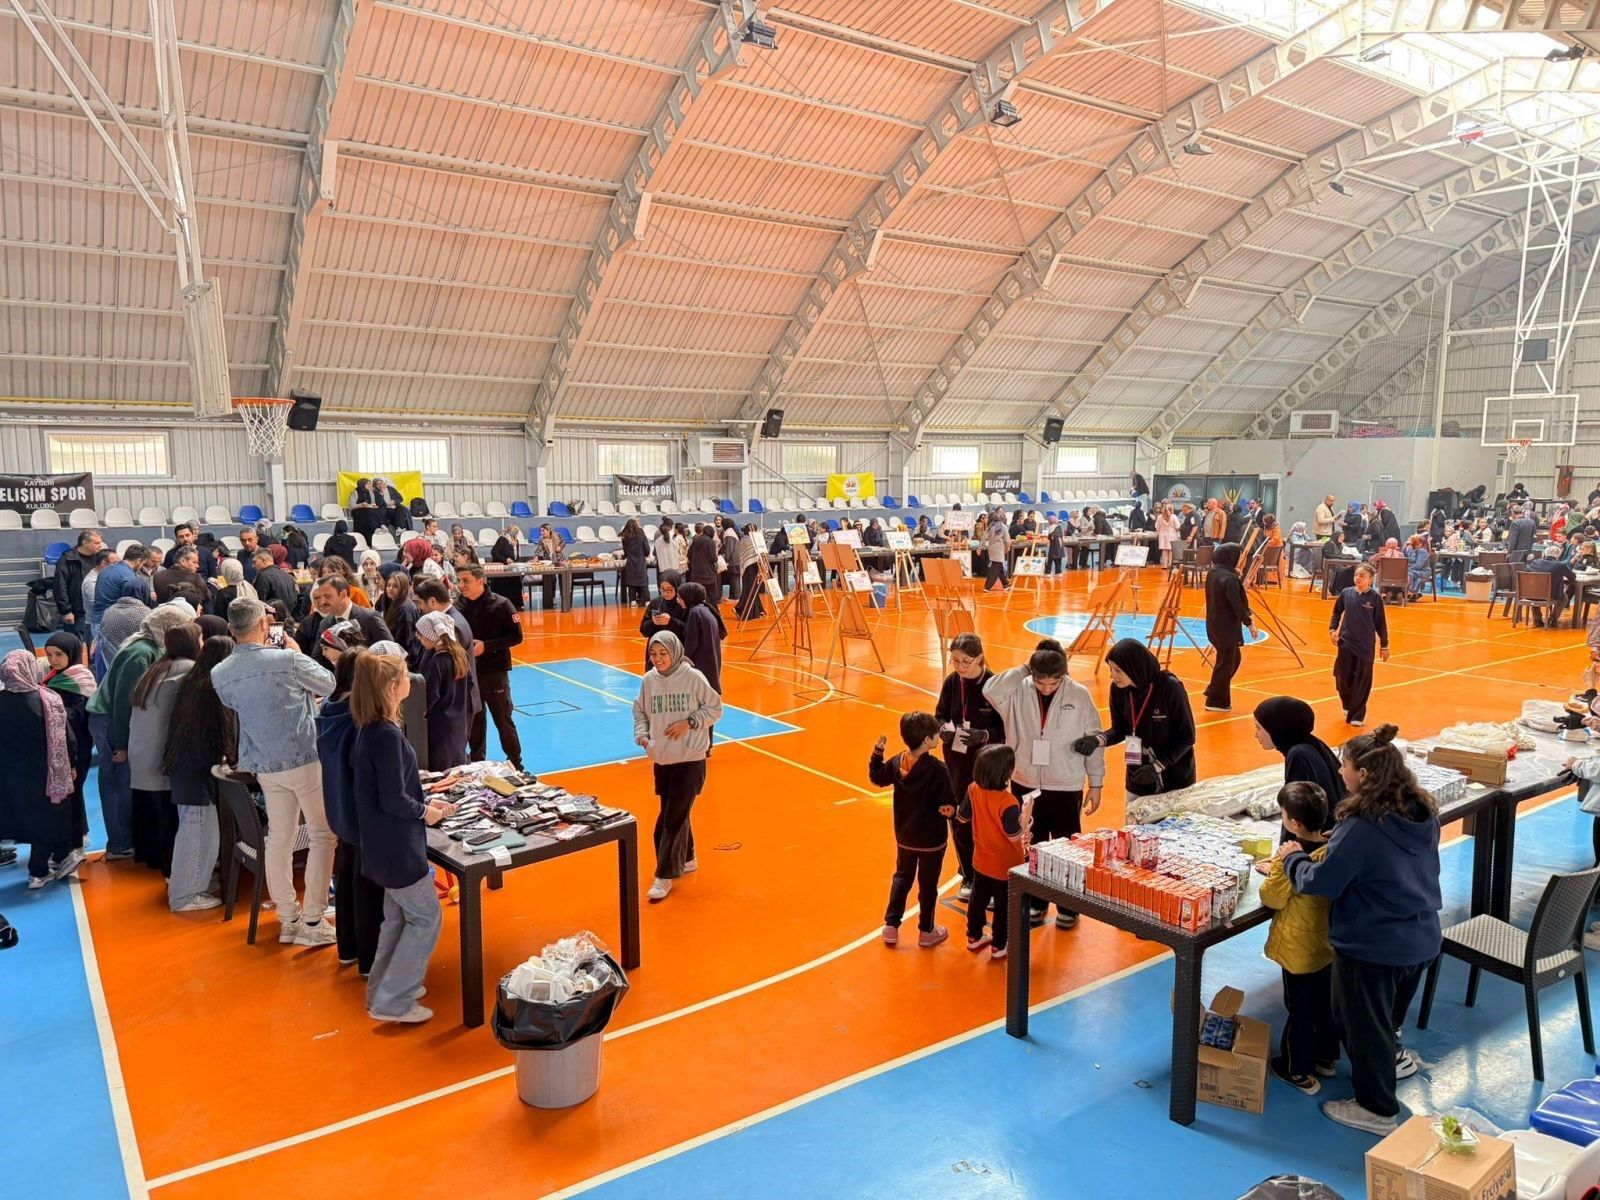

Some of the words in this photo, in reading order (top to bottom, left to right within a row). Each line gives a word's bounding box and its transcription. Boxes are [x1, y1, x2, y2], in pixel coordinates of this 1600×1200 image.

[50, 486, 86, 501] SPOR
[650, 484, 672, 496] SPOR
[665, 693, 691, 712] JERSEY
